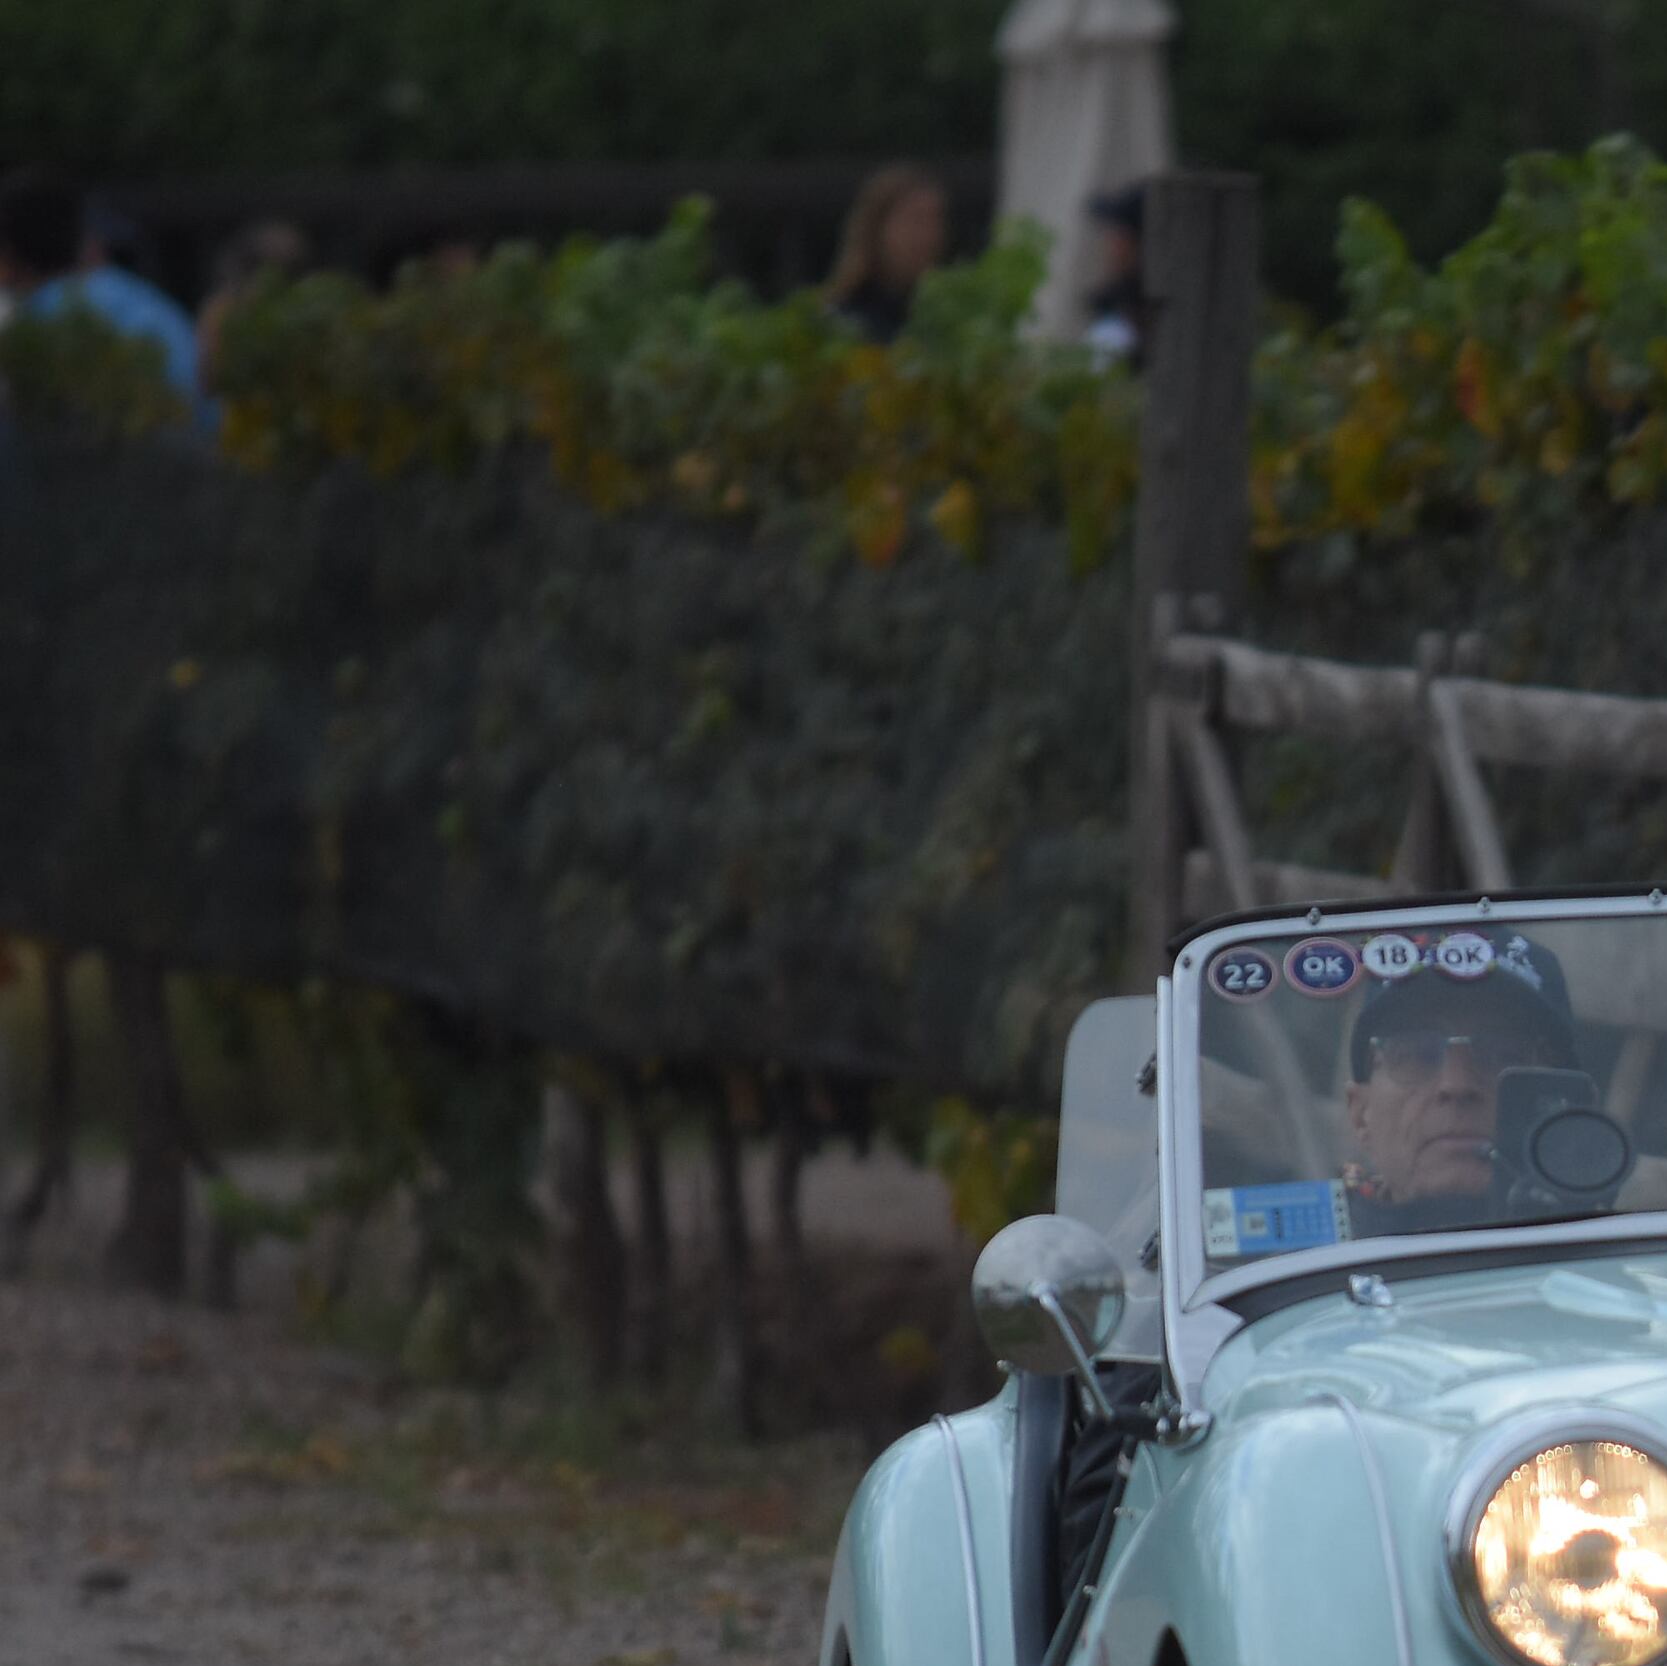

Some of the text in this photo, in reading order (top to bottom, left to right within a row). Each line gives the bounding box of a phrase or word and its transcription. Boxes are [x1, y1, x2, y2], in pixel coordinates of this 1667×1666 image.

[1302, 955, 1345, 975] OK
[1375, 944, 1409, 966] 18
[1445, 945, 1482, 965] OK
[1223, 963, 1265, 989] 22
